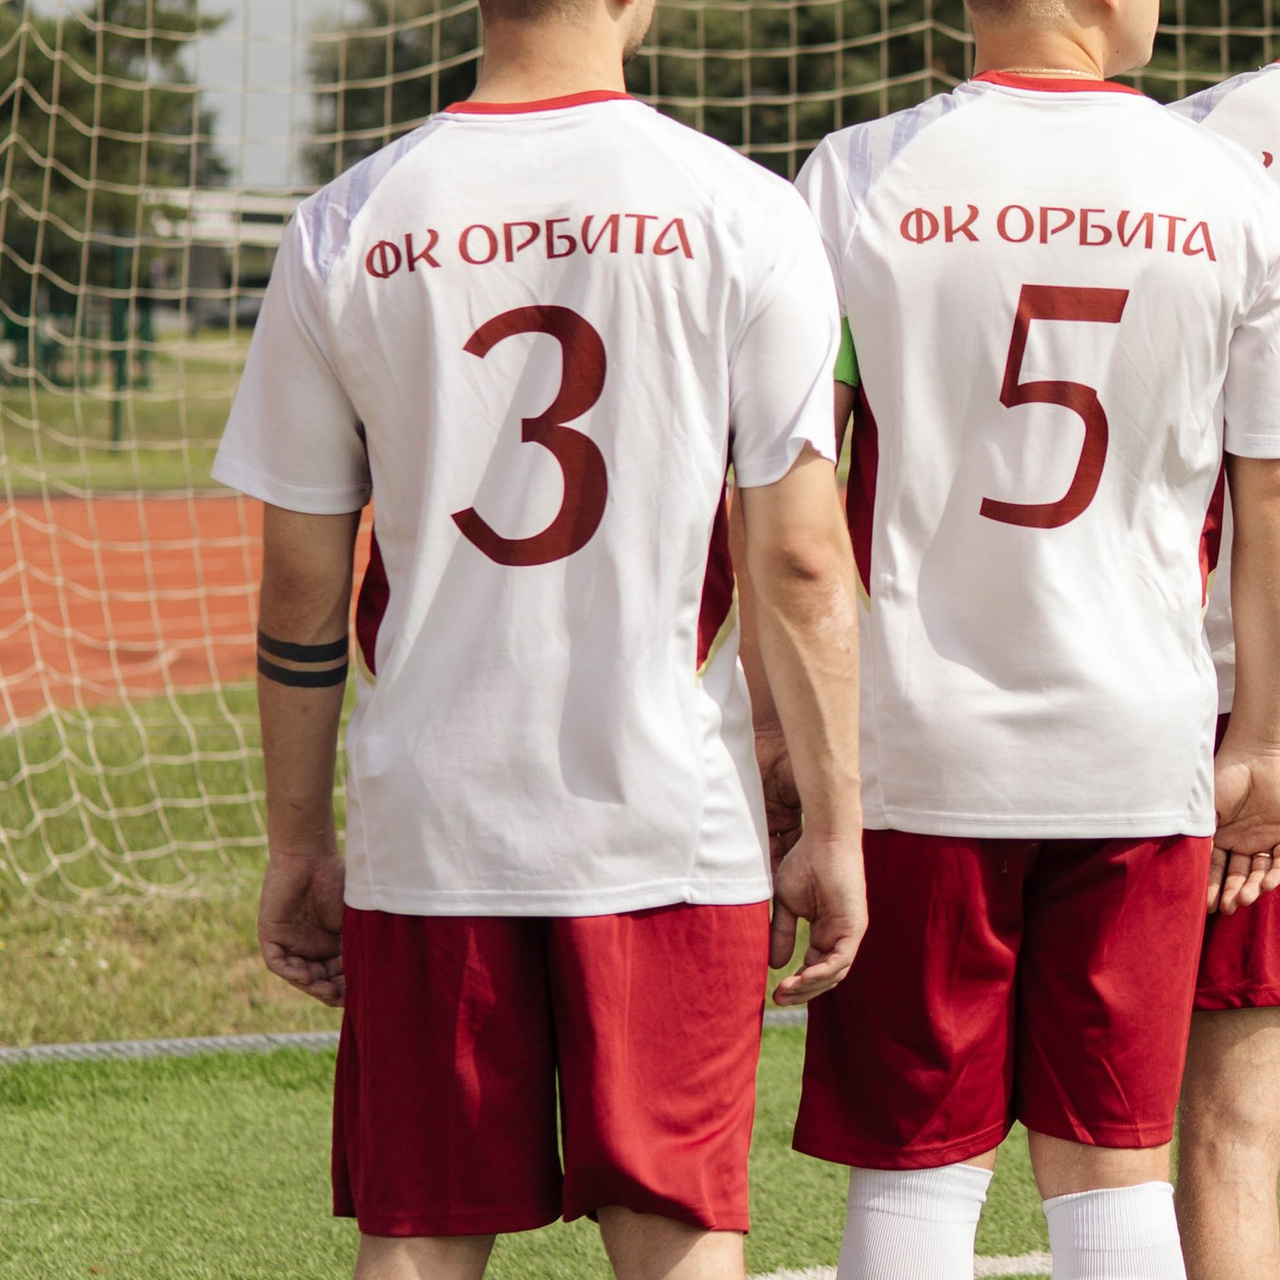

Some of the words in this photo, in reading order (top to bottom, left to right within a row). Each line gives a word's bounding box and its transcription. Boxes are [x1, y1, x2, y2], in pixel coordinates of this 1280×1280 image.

[365, 228, 441, 280] ФК
[459, 214, 693, 265] ОРБИТА
[899, 204, 979, 244] ФК
[997, 205, 1216, 262] ОРБИТА
[450, 305, 608, 567] 3
[979, 284, 1129, 529] 5
